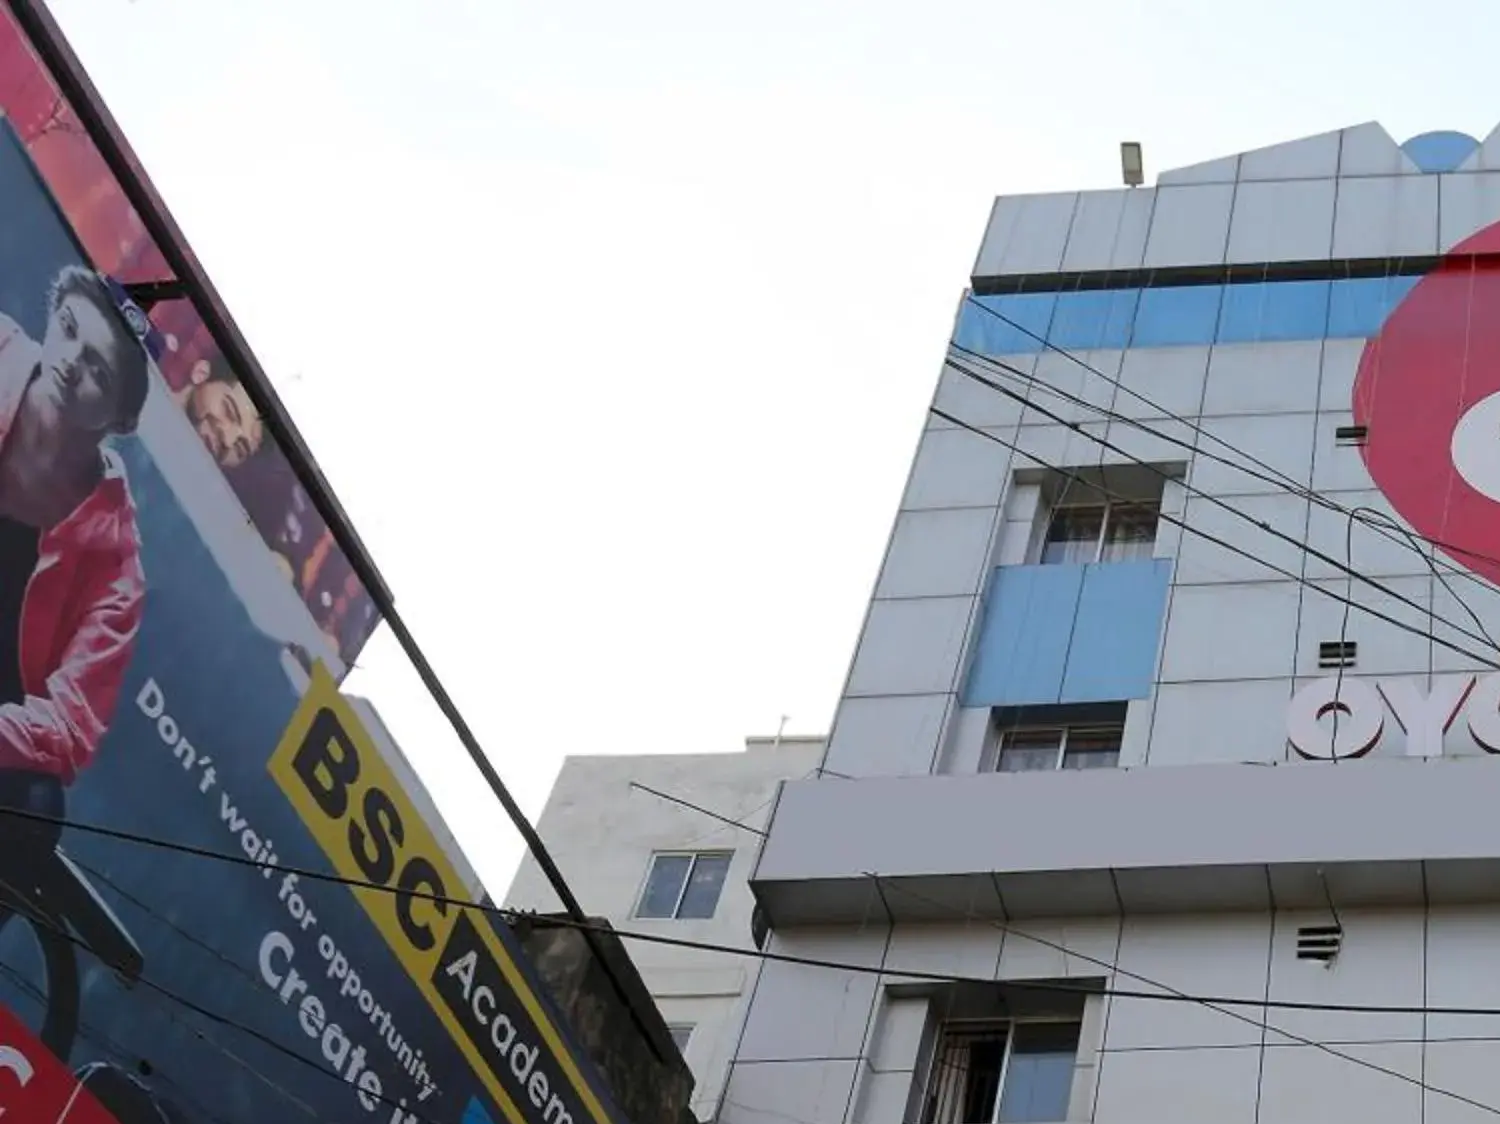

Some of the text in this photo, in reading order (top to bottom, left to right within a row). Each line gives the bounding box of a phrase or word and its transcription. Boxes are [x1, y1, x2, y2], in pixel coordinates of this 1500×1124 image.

[135, 678, 441, 1103] Don't wait for opportunity
[291, 706, 450, 953] BSC
[258, 930, 384, 1113] Create
